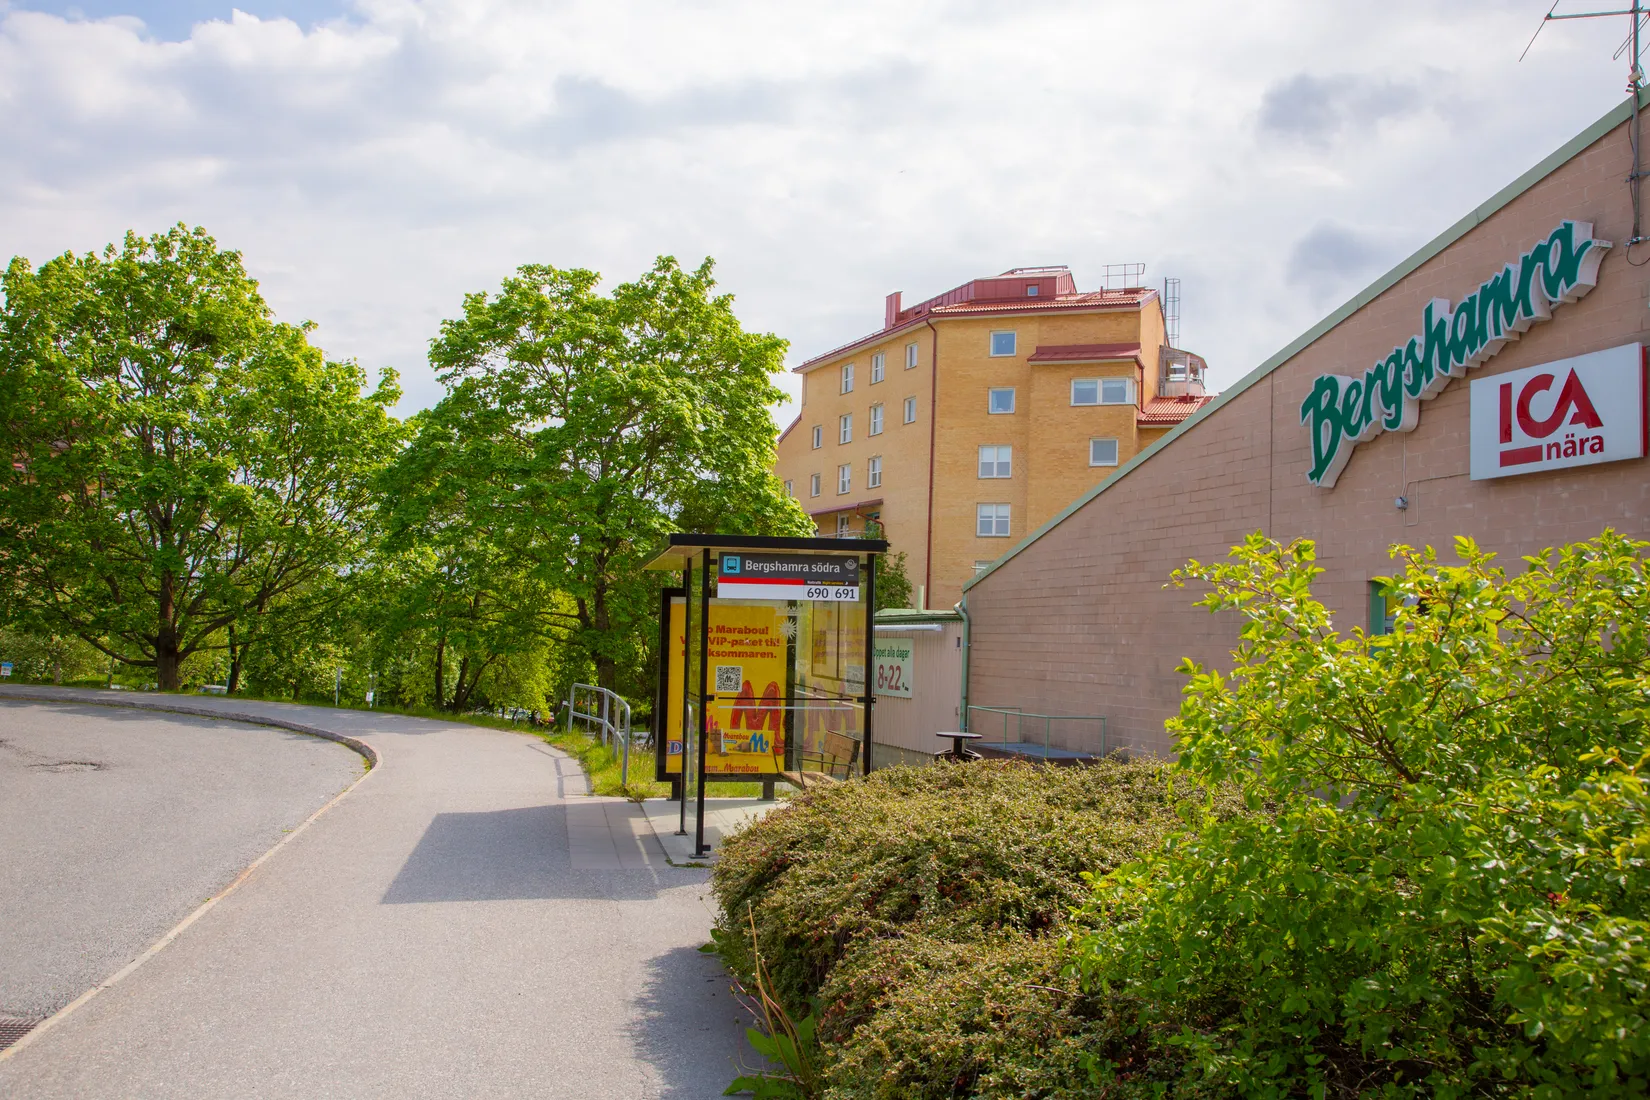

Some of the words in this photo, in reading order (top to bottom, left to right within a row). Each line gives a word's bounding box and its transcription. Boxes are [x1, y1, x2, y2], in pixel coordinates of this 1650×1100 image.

[1300, 219, 1600, 487] Bergshamra
[1499, 367, 1604, 445] ICA
[1546, 433, 1605, 461] nära
[745, 559, 809, 573] Bergshamra
[811, 561, 841, 573] södra
[807, 587, 829, 599] 690
[835, 588, 855, 599] 691
[716, 624, 769, 635] Marabou!
